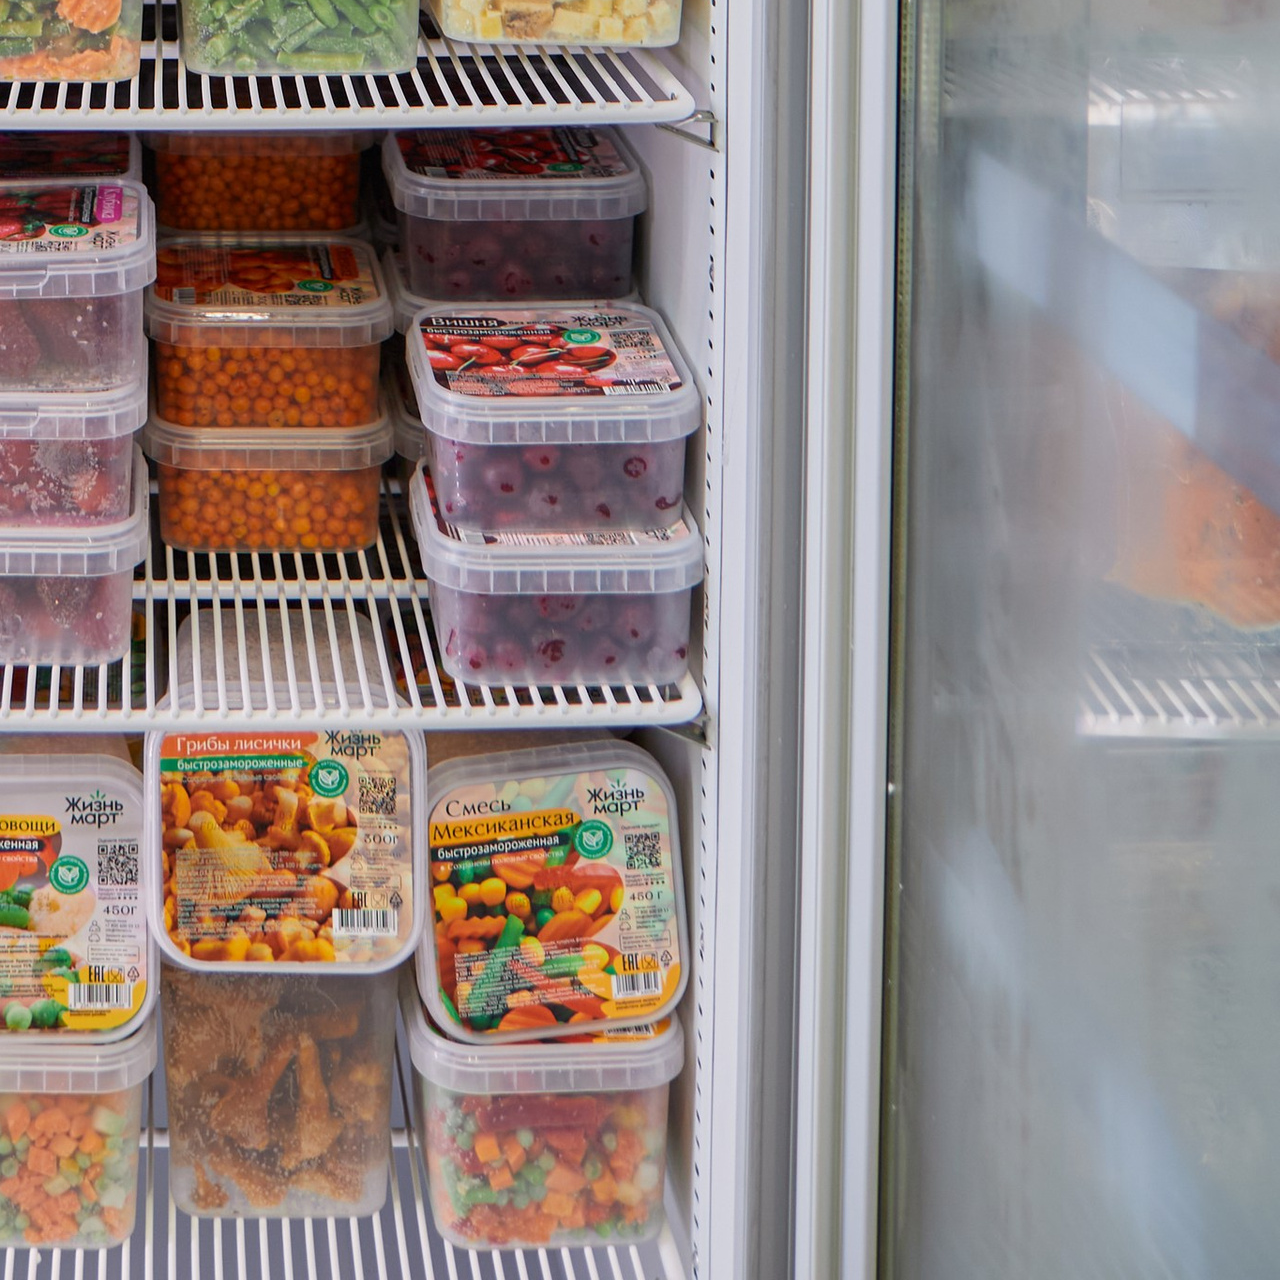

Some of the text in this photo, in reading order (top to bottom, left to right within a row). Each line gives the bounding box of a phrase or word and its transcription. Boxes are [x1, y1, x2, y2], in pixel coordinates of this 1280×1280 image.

[431, 317, 498, 327] Вишня
[426, 328, 551, 336] быстрозамороженная
[324, 730, 381, 744] Жизнь
[177, 736, 301, 755] Грибы лисички
[330, 745, 377, 760] март
[177, 758, 303, 771] быстрозамороженные
[587, 788, 645, 803] Жизнь
[65, 796, 124, 813] Жизнь
[446, 799, 511, 817] Смесь
[593, 799, 642, 817] март
[70, 812, 120, 828] март
[433, 812, 575, 841] Мексиканская
[438, 835, 559, 859] быстрозамороженная
[629, 892, 654, 902] 450
[103, 905, 137, 916] 450г
[622, 954, 640, 971] EAC
[88, 966, 106, 983] EAC
